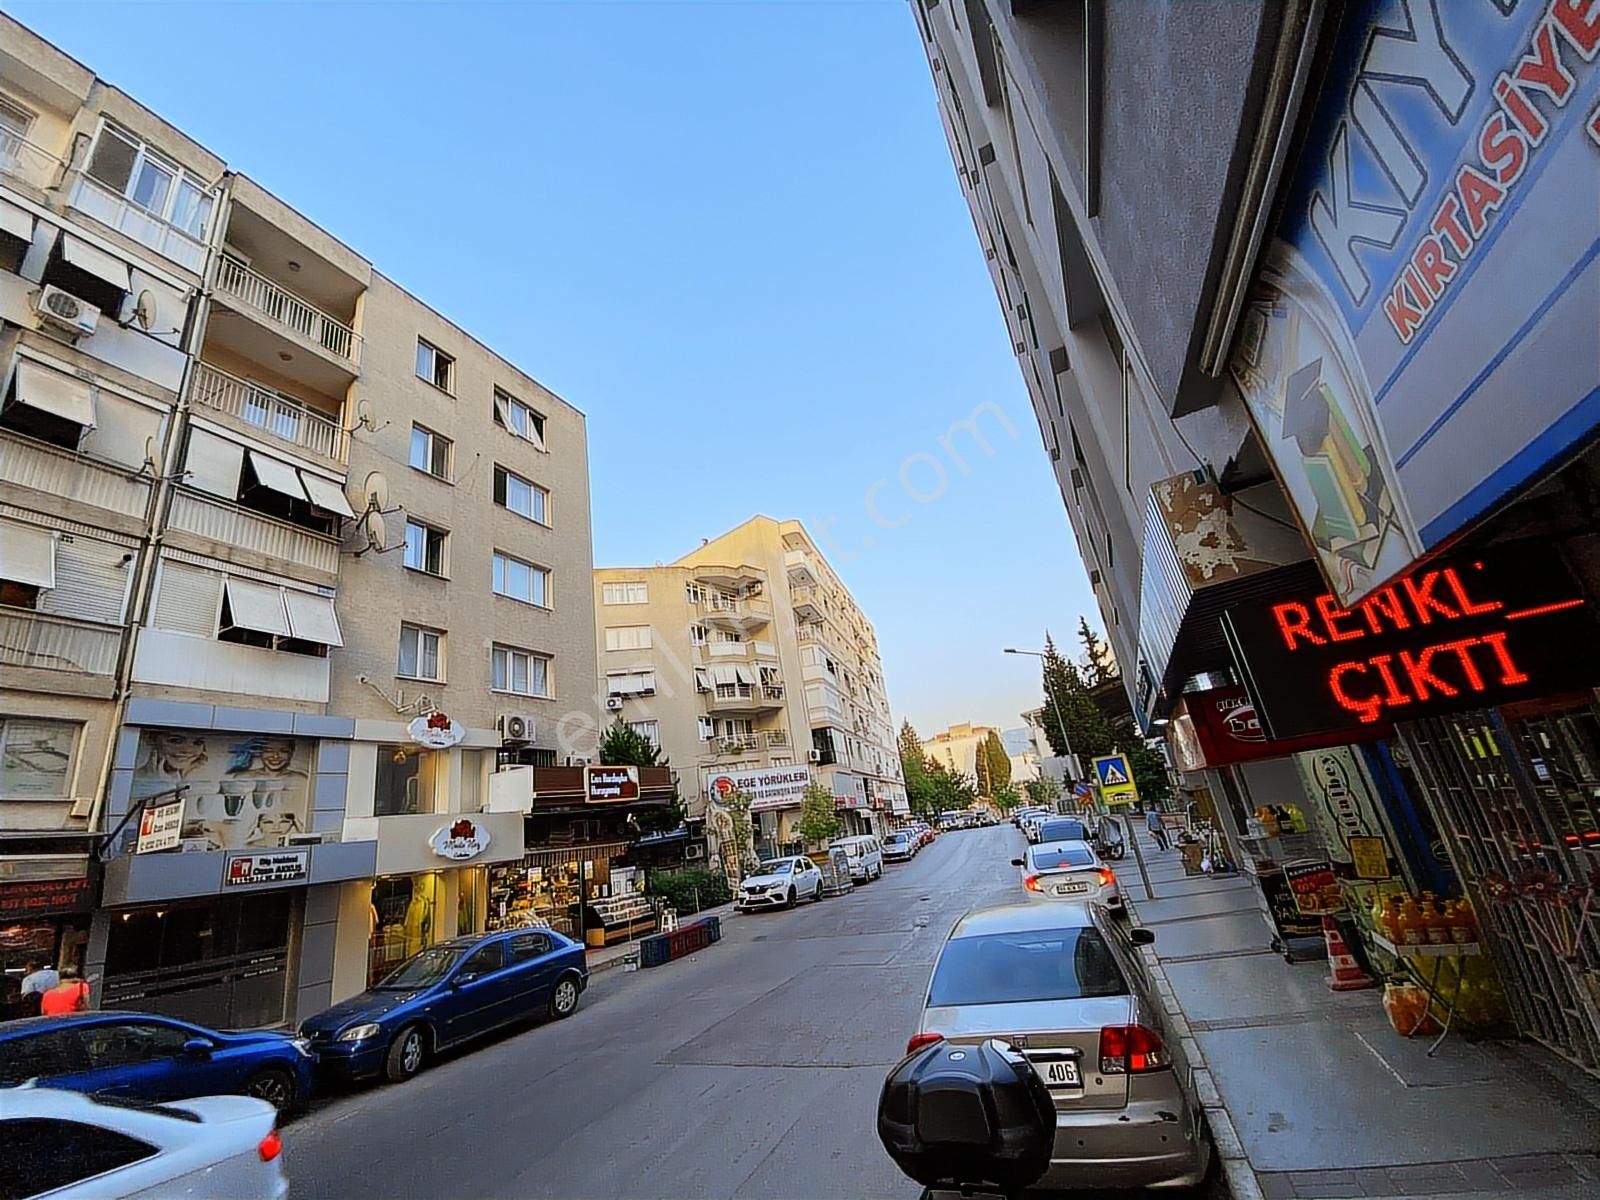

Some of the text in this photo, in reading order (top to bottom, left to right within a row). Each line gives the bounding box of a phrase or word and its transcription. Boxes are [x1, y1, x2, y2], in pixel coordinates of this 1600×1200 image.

[1309, 0, 1520, 307] KIY
[1381, 0, 1600, 345] KIRTASİYE
[1329, 631, 1529, 723] ÇIKTI
[737, 770, 808, 788] EGE YÖRÜKLERİ
[1048, 1063, 1074, 1082] 406
